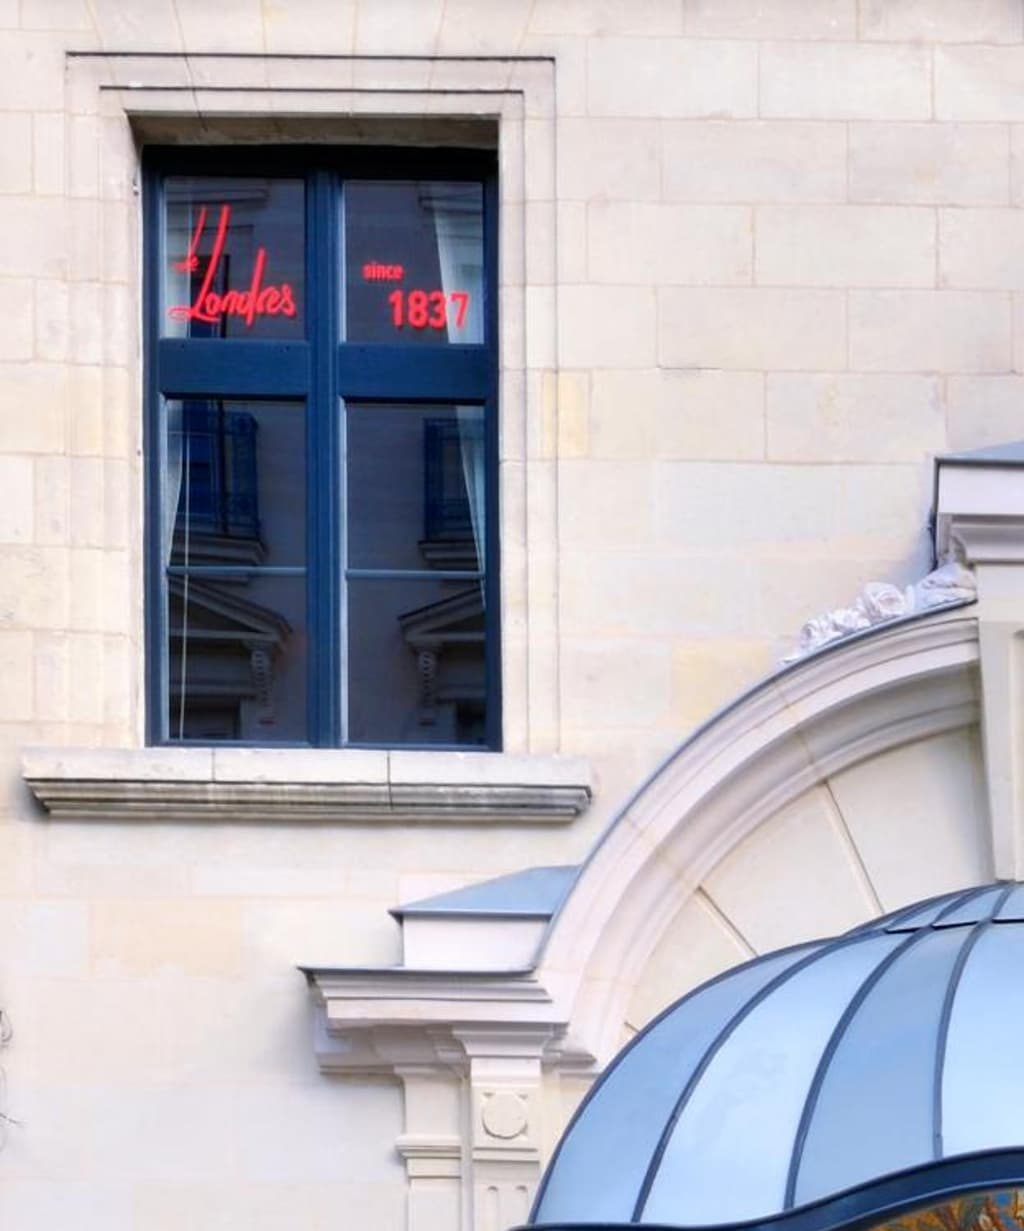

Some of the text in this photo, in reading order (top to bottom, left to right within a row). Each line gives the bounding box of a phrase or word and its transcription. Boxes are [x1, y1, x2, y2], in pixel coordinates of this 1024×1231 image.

[167, 203, 296, 328] Londres
[363, 260, 404, 280] since
[387, 290, 469, 328] 1837
